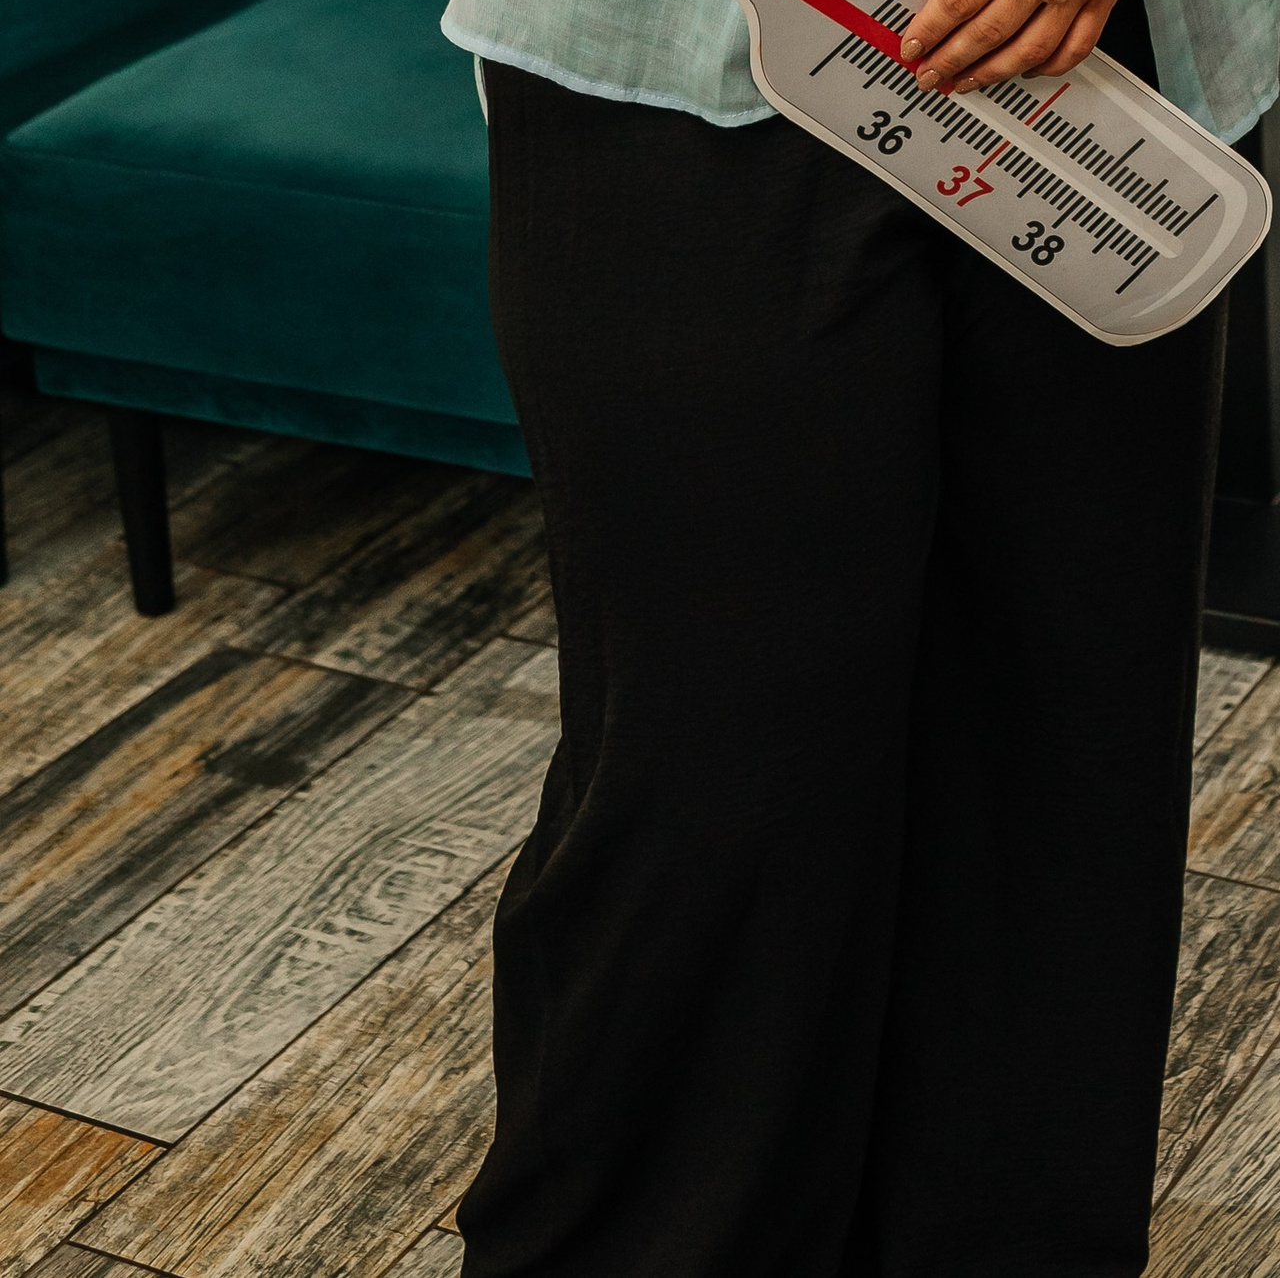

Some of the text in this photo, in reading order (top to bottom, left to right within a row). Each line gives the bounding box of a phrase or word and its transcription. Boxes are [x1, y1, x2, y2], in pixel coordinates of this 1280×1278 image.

[857, 110, 912, 155] 36
[936, 165, 995, 207] 37
[1011, 220, 1065, 266] 38
